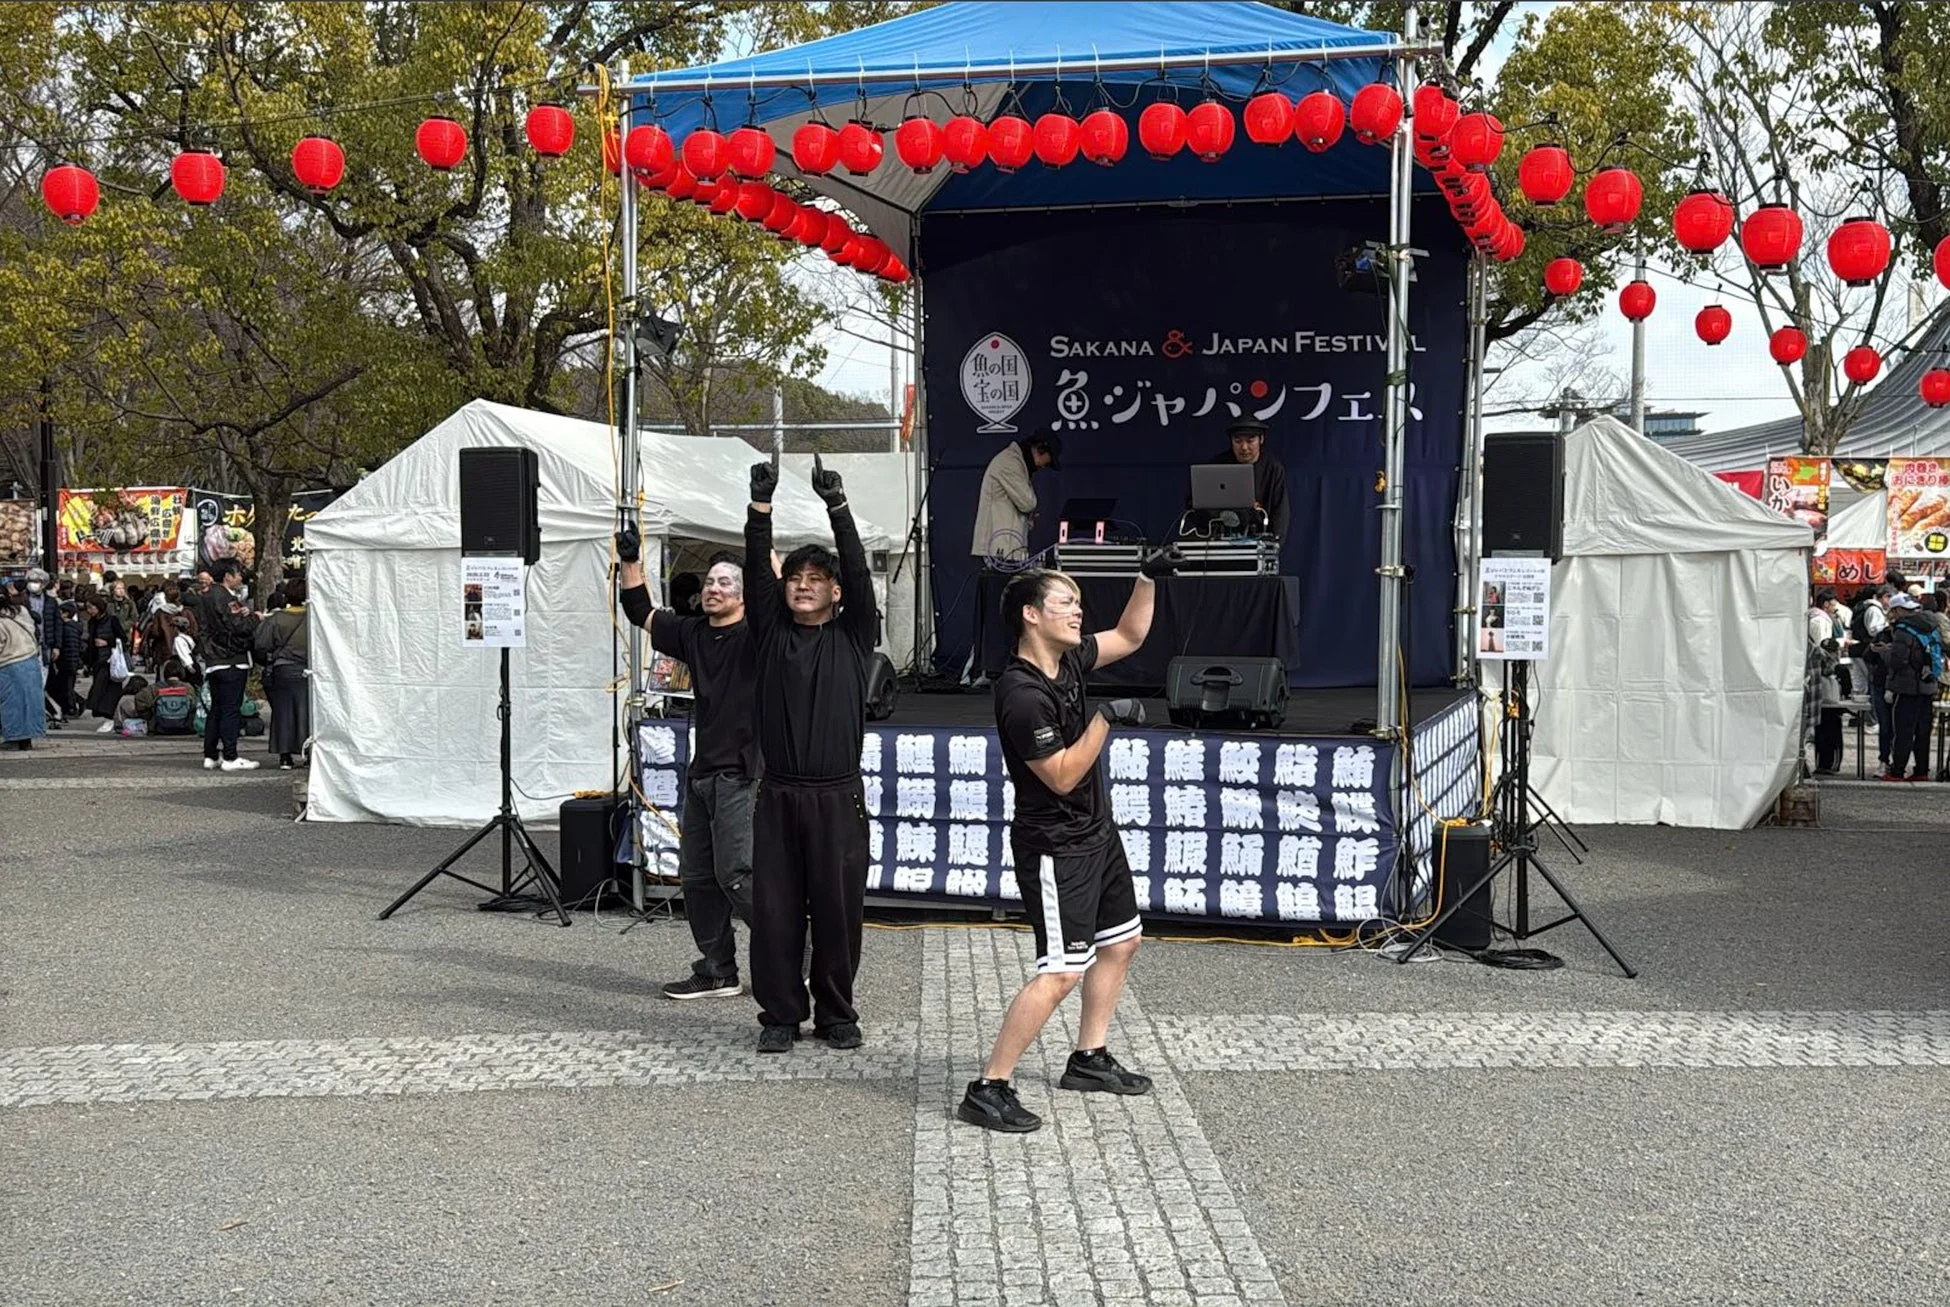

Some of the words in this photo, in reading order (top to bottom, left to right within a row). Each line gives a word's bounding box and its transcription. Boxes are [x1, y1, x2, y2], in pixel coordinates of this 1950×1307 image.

[1050, 335, 1155, 358] SAKANA
[1201, 332, 1288, 355] JAPAN
[1295, 331, 1427, 353] FESTIVL
[970, 353, 1018, 377] 魚の国
[973, 379, 1019, 403] 宝の国
